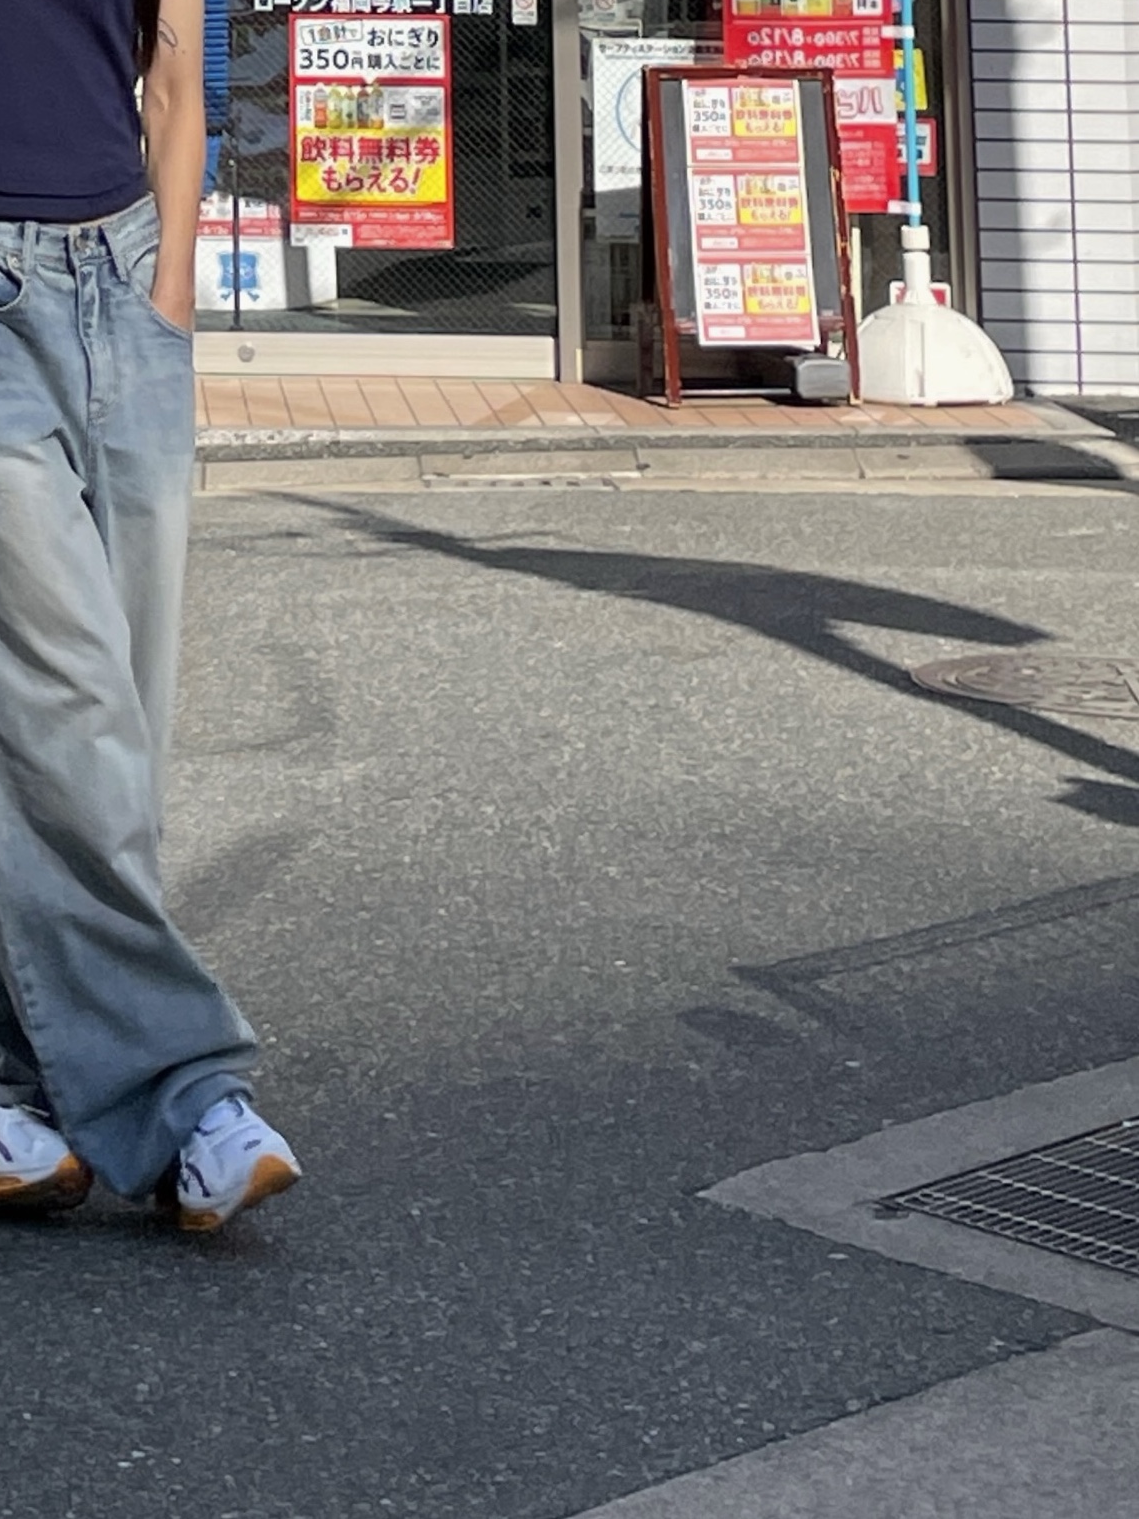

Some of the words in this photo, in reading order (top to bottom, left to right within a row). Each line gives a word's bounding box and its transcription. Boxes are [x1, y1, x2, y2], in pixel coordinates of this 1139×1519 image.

[366, 28, 439, 48] おにぎり
[299, 48, 363, 70] 350円
[367, 52, 441, 71] 購入ごとに
[301, 135, 440, 164] 飲料無料券
[322, 166, 421, 194] もらえる!
